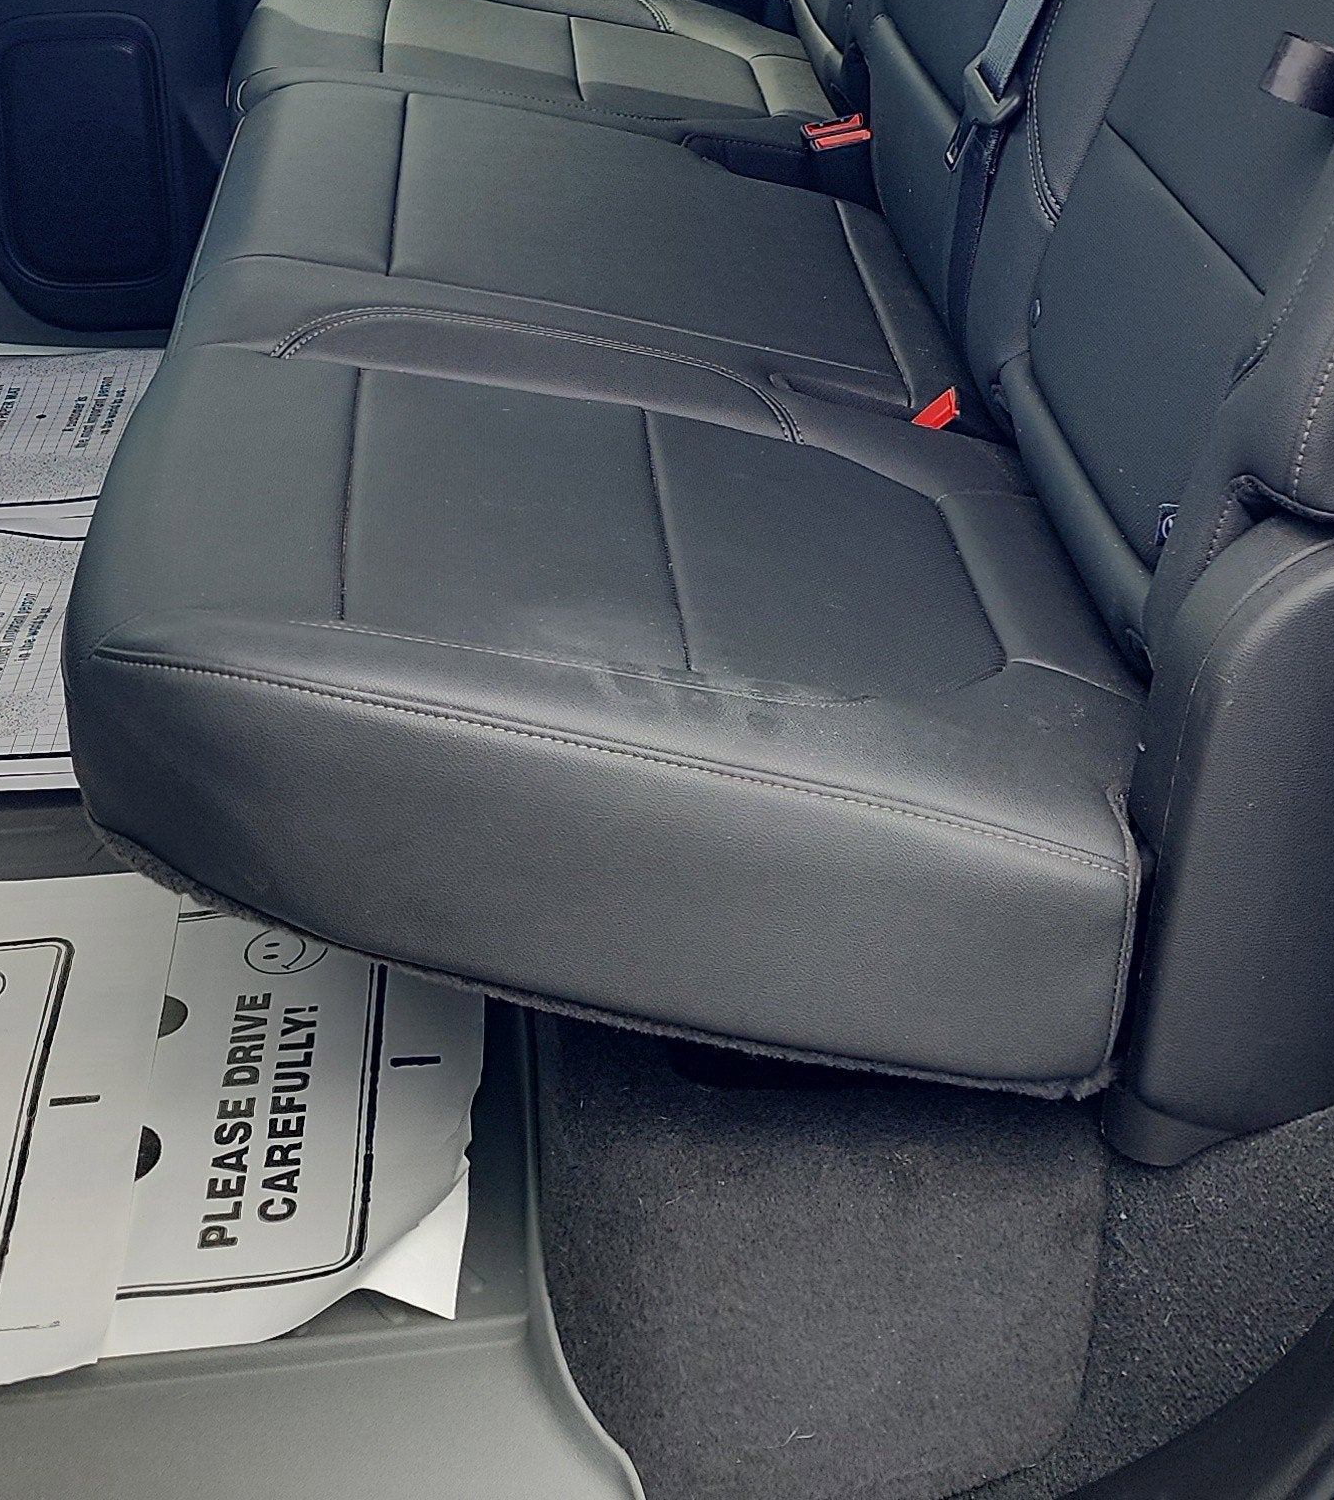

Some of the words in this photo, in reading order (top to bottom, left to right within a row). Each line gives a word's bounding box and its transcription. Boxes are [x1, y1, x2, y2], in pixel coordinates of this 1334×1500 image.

[5, 388, 20, 399] MAT
[17, 593, 36, 614] person
[18, 638, 36, 651] the
[222, 993, 271, 1087] DRIVE
[257, 1005, 318, 1223] CAREFULLY!
[197, 1098, 256, 1249] PLEASE
